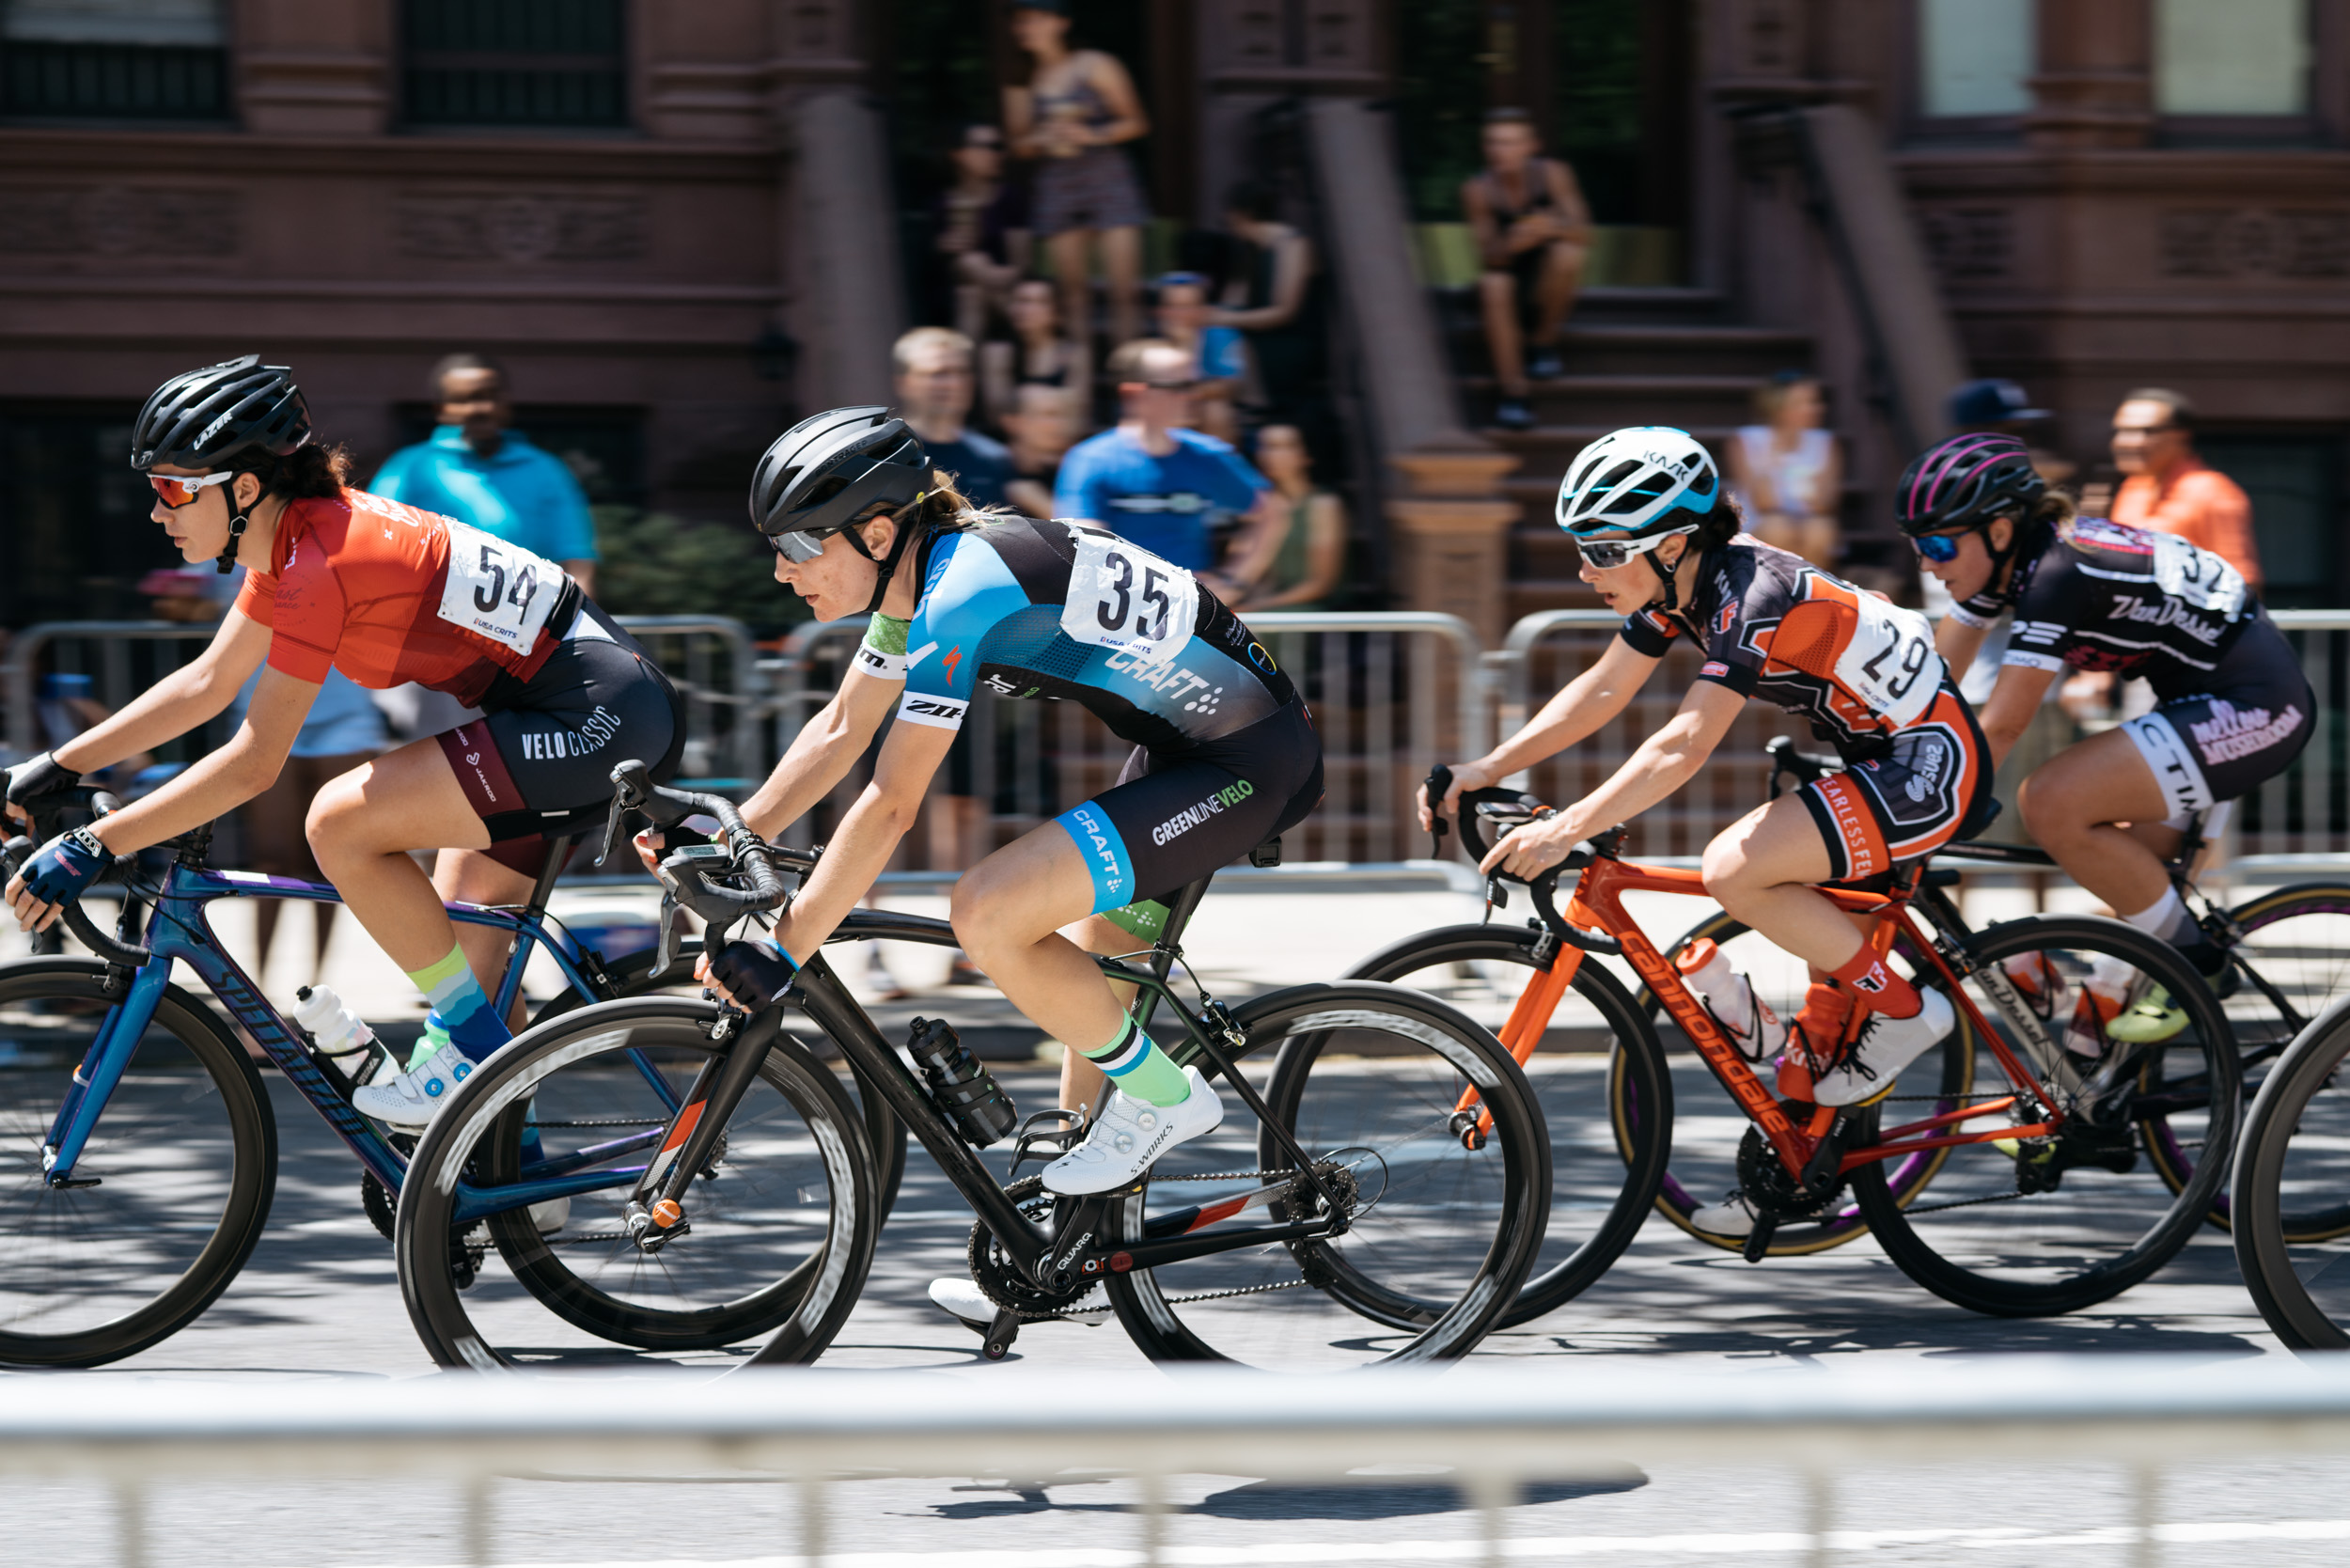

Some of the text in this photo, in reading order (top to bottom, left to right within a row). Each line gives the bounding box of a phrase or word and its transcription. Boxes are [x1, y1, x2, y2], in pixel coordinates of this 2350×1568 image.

[193, 412, 233, 451] LAZER
[815, 439, 868, 477] BONTRAGER
[1643, 449, 1689, 482] KASK
[473, 544, 538, 626] 54
[1097, 551, 1169, 642] 35
[478, 619, 494, 631] USA
[494, 625, 518, 640] CRITS
[1105, 635, 1125, 647] USA
[1104, 651, 1211, 700] CRAFT
[1861, 619, 1929, 700] 29
[476, 767, 497, 803] JAKROO
[1818, 776, 1866, 848] FEARLESS
[1073, 809, 1120, 876] CRAFT
[212, 970, 369, 1137] SPECIALIZED
[1619, 930, 1790, 1134] cannondale
[1130, 1121, 1174, 1177] S-WORKS
[1057, 1231, 1093, 1271] QUARQ
